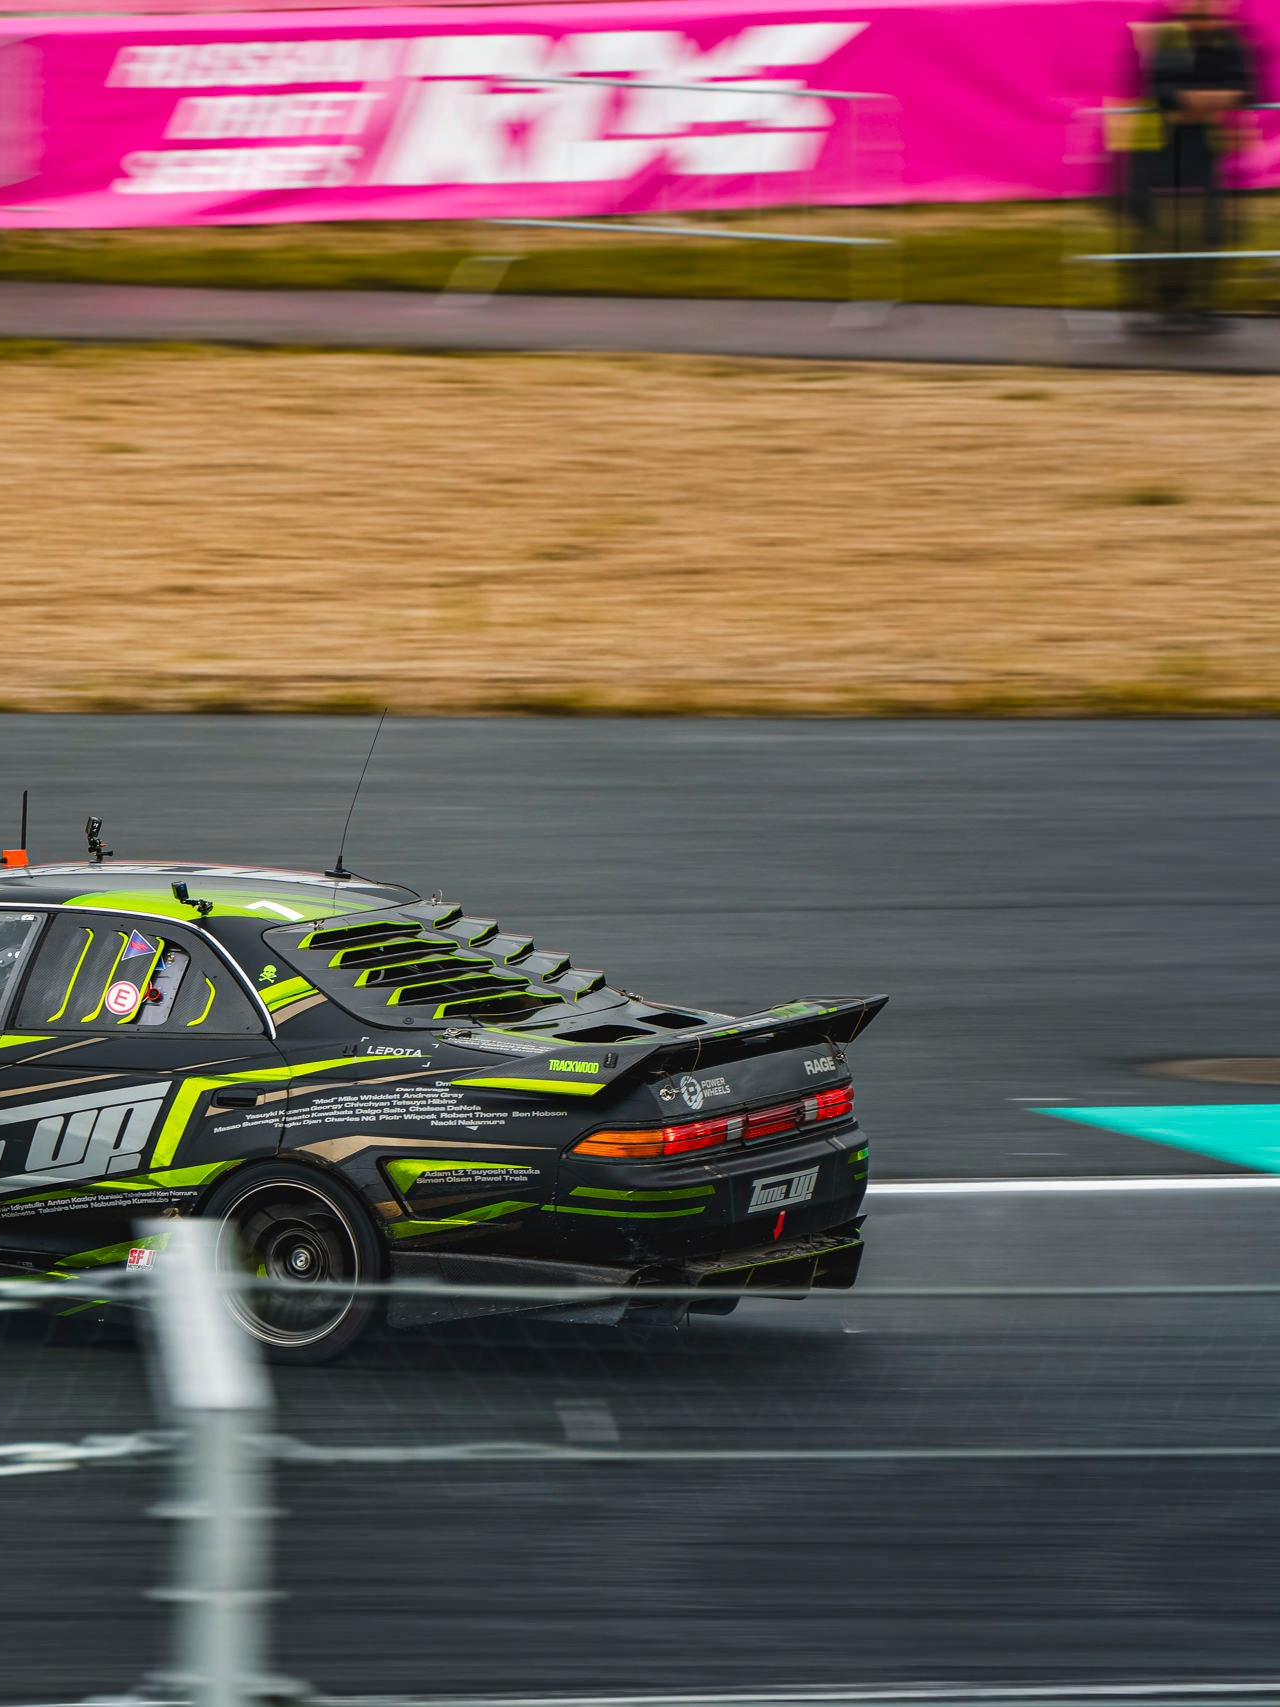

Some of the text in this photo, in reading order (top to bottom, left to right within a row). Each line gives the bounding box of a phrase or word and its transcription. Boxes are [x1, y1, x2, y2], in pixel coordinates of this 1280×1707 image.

[113, 988, 131, 1008] E
[366, 1045, 422, 1058] LEPOTA
[548, 1059, 600, 1074] TRACKWOOD
[803, 1055, 836, 1076] RAGE
[700, 1077, 726, 1089] POWER
[359, 1093, 400, 1101] Whiddett
[703, 1085, 731, 1098] WHEELS
[324, 1115, 360, 1123] Charles
